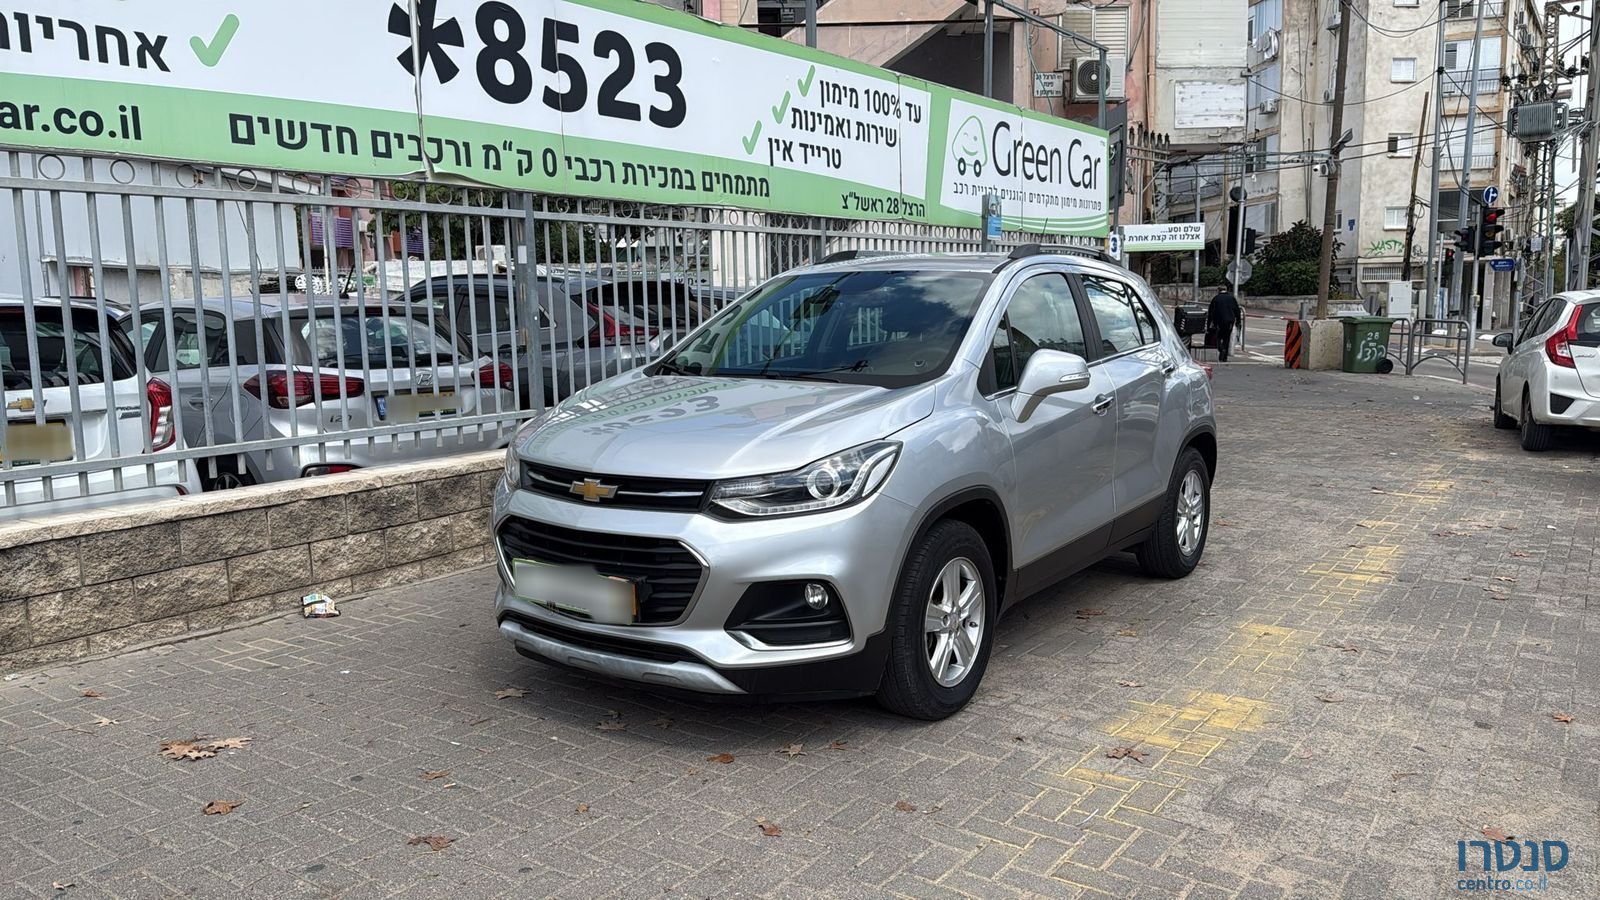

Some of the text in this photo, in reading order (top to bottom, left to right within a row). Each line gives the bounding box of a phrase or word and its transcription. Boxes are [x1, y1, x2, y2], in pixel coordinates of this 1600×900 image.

[819, 80, 922, 123] עד 100% מימון
[0, 101, 142, 141] ar.co.il
[228, 113, 358, 156] חדשים
[791, 107, 897, 148] שירות ואמינות
[370, 130, 472, 168] ורכבים
[542, 147, 558, 177] 0
[768, 136, 842, 170] טרייד אין
[992, 121, 1101, 190] Green Car
[564, 155, 615, 183] רכבי
[622, 161, 696, 191] במכירת
[702, 170, 770, 198] מתמחים
[953, 182, 969, 195] רכב
[1000, 188, 1027, 202] והוגנים
[841, 191, 925, 217] הרצל 28 ראשל"צ
[1028, 193, 1059, 207] מתקדמים
[1061, 197, 1077, 210] מימון
[1079, 199, 1102, 211] פתרונות
[1128, 234, 1149, 242] אחרת
[1151, 234, 1167, 242] קצת
[1179, 233, 1201, 241] אצלנו
[1183, 225, 1201, 233] שלם
